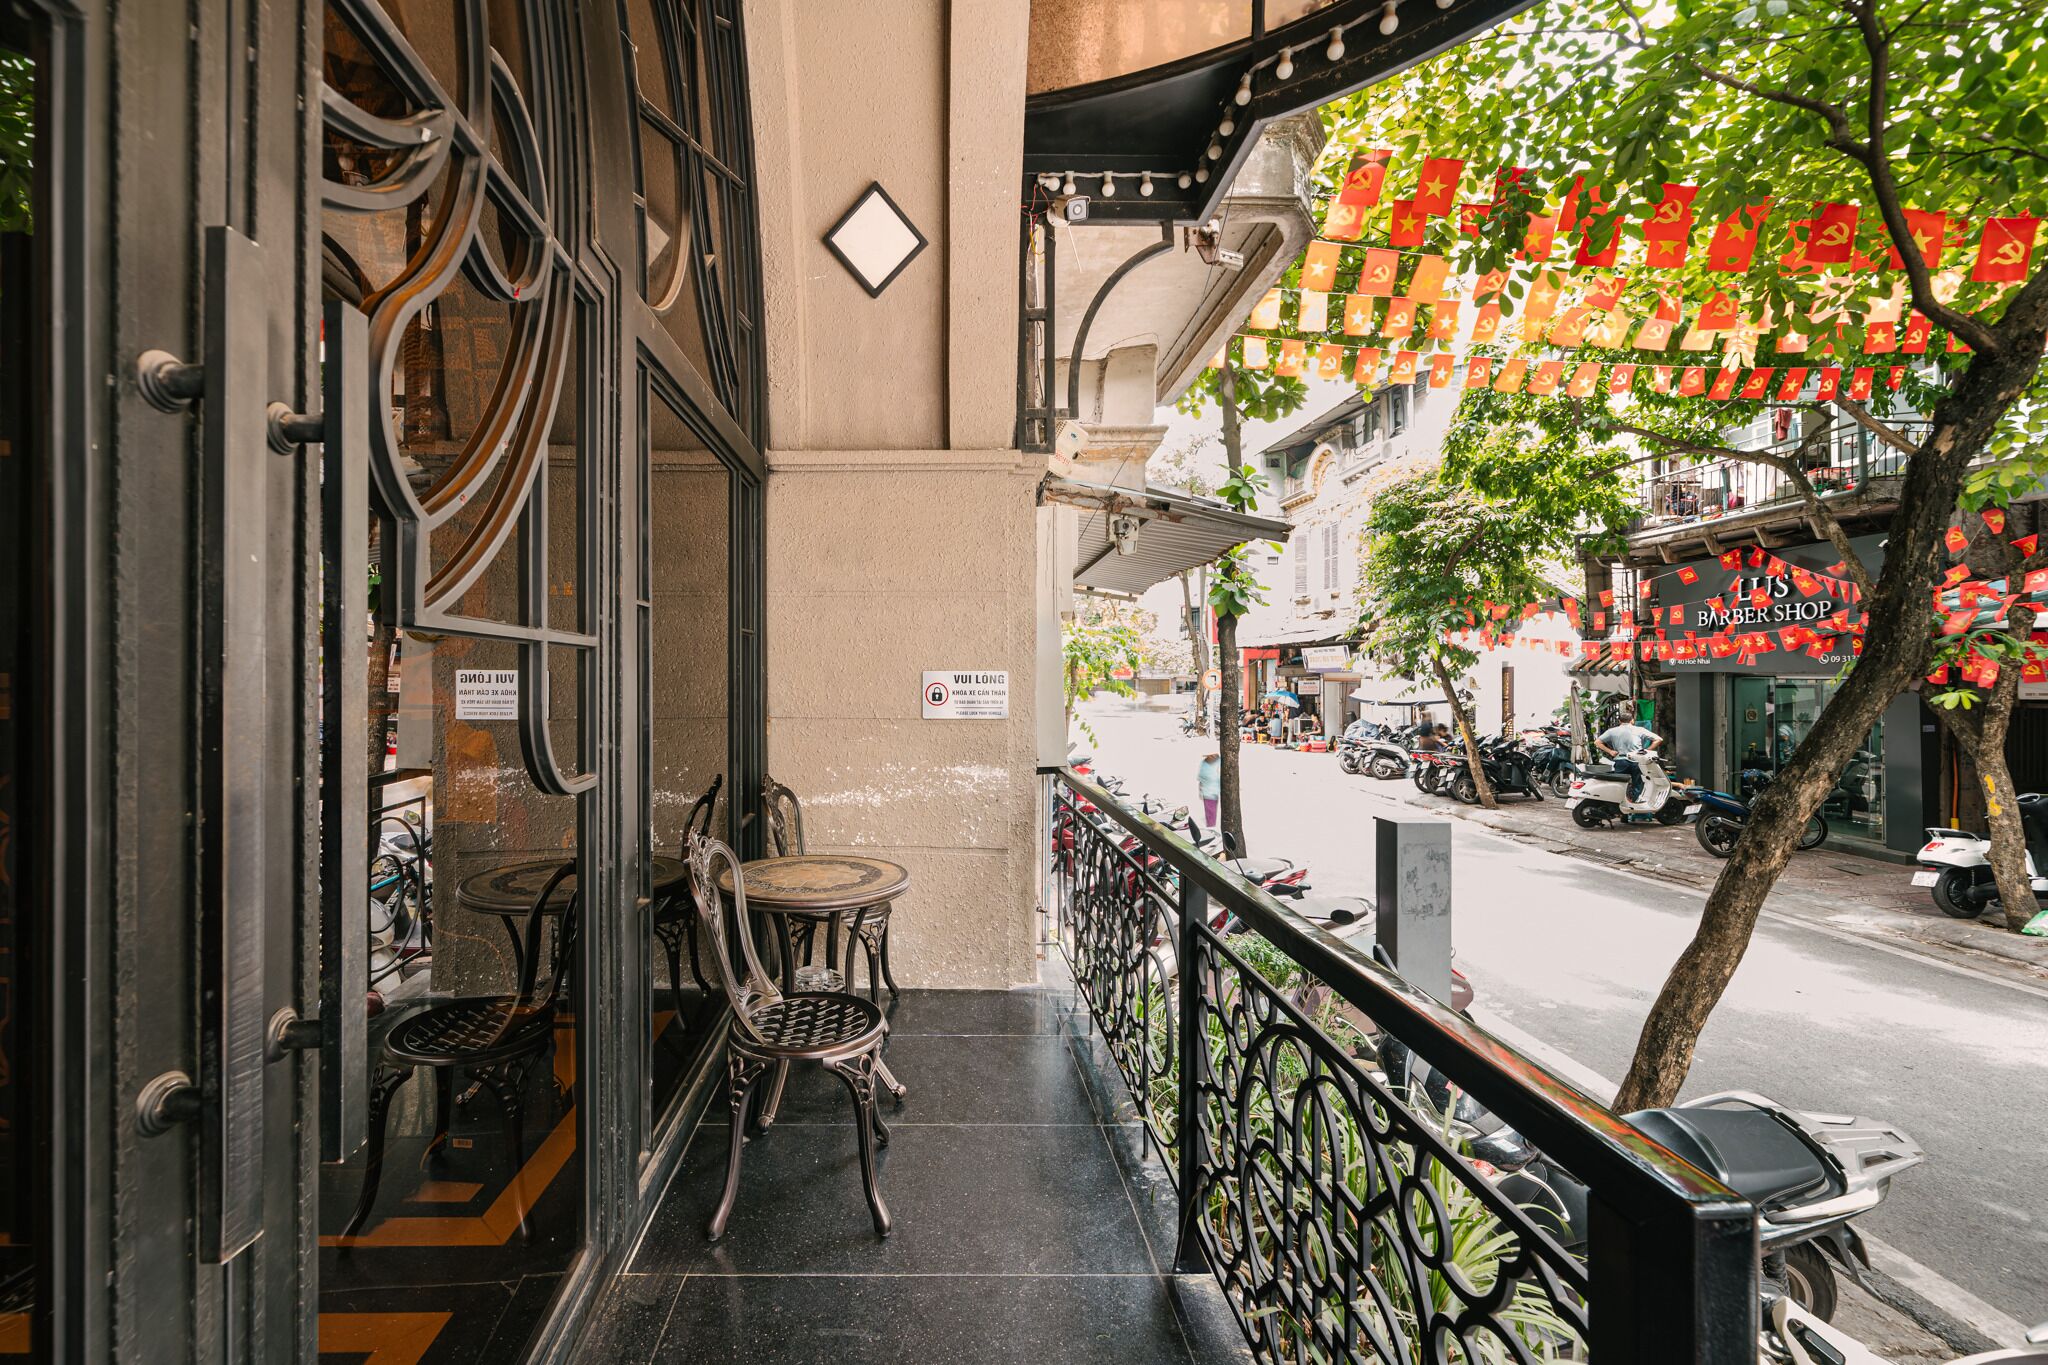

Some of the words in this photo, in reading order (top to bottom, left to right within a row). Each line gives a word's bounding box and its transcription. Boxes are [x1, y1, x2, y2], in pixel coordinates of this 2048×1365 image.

[1697, 605, 1771, 628] BARBER
[1774, 600, 1832, 622] SHOP
[1830, 655, 1841, 663] 09
[954, 674, 972, 684] VUI
